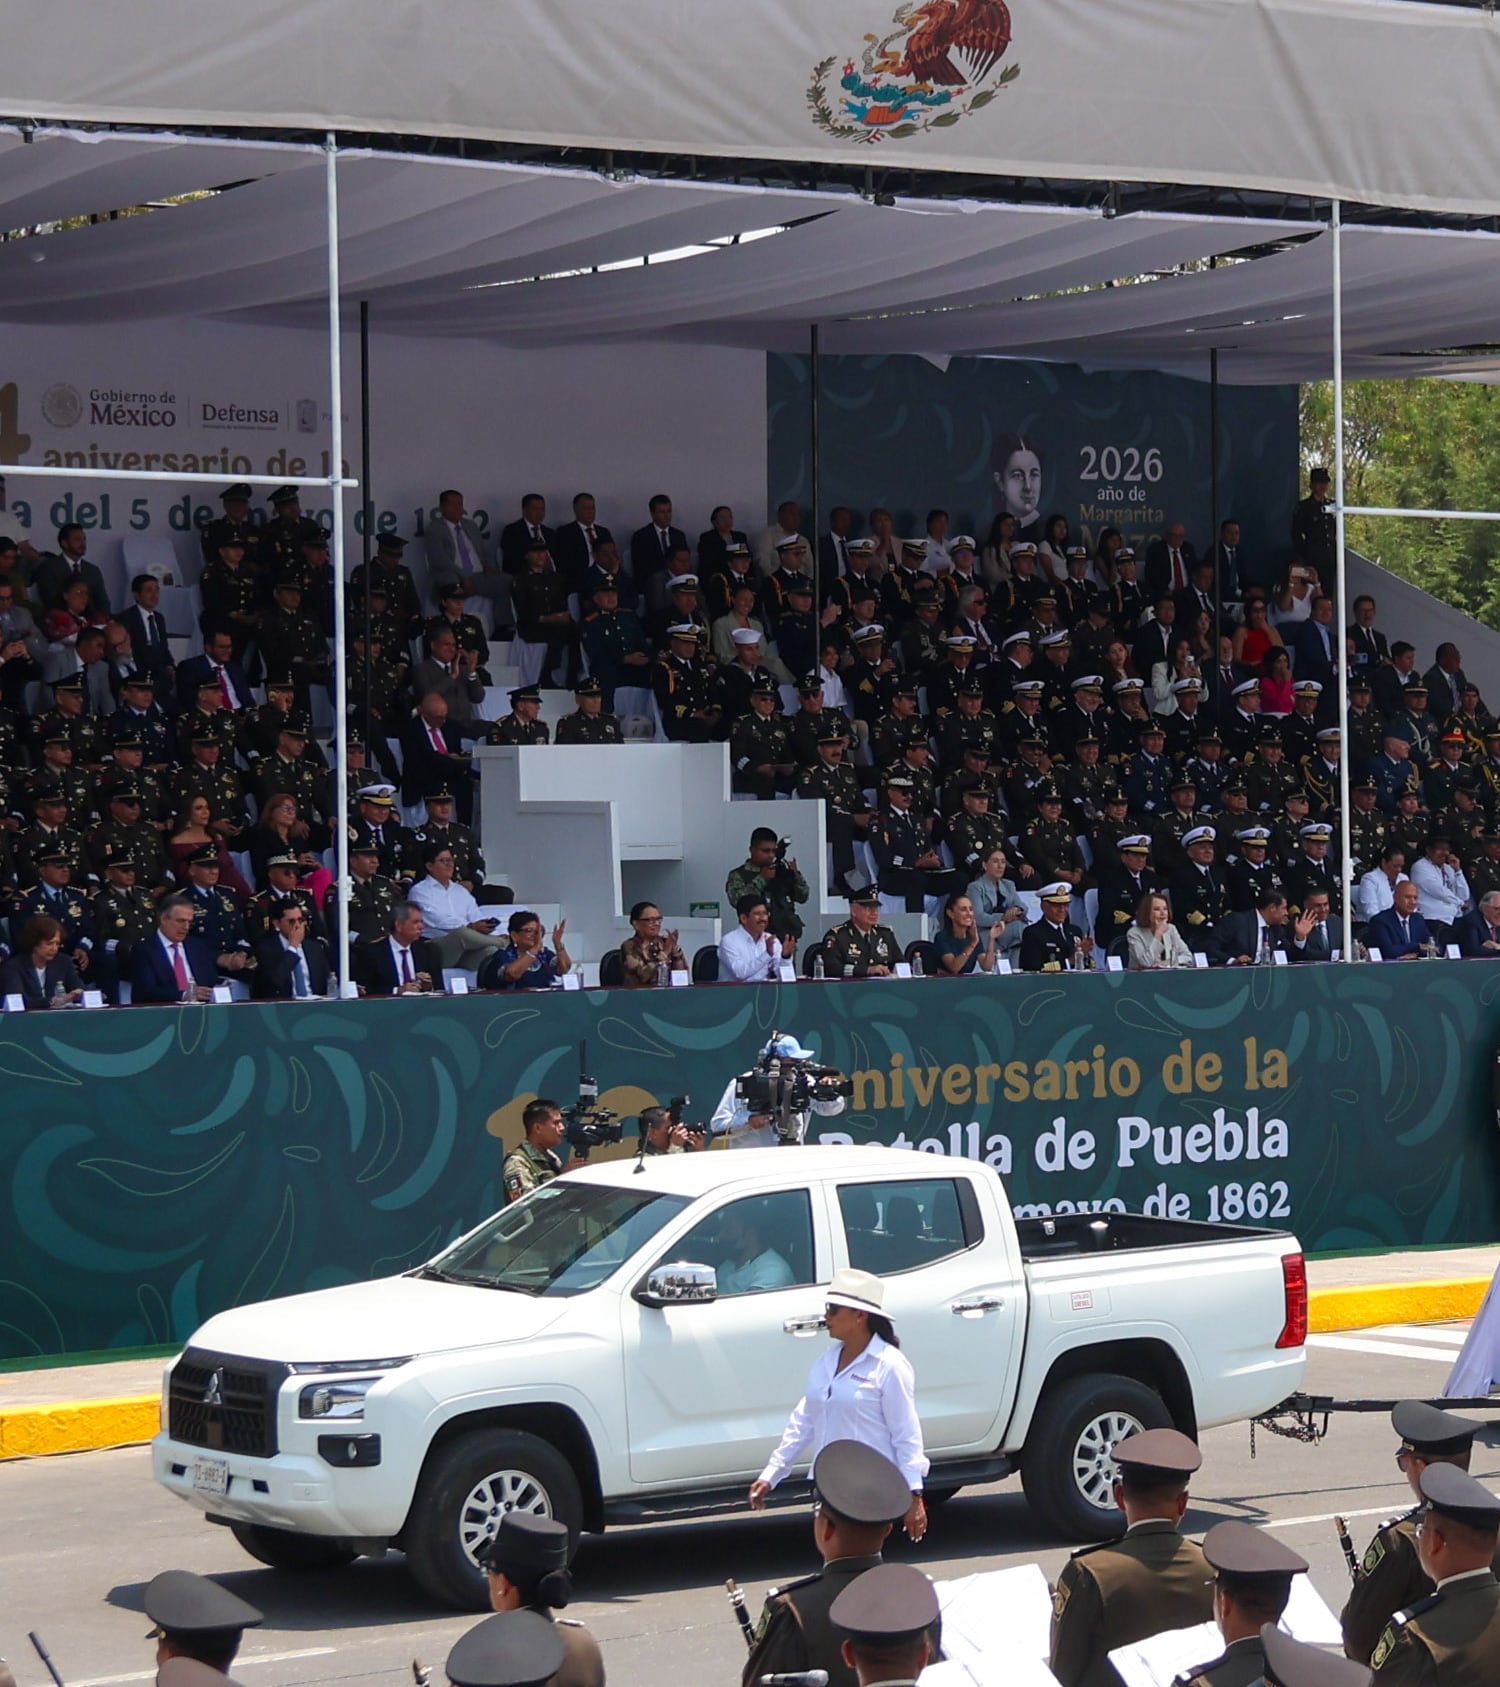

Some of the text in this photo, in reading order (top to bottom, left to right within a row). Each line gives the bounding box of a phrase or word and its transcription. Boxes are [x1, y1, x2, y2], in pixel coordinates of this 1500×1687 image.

[89, 389, 176, 404] Gobierno de
[90, 402, 176, 427] México
[202, 404, 279, 423] Defensa
[1080, 446, 1163, 482] 2026
[1097, 485, 1147, 502] año de
[50, 492, 112, 531] del
[129, 498, 151, 531] 5
[1080, 503, 1164, 525] Margarita
[838, 1036, 1289, 1111] niversario de la
[1035, 1116, 1096, 1173] de
[1117, 1107, 1289, 1168] Puebla
[1143, 1182, 1191, 1220] de
[1207, 1180, 1292, 1222] 1862
